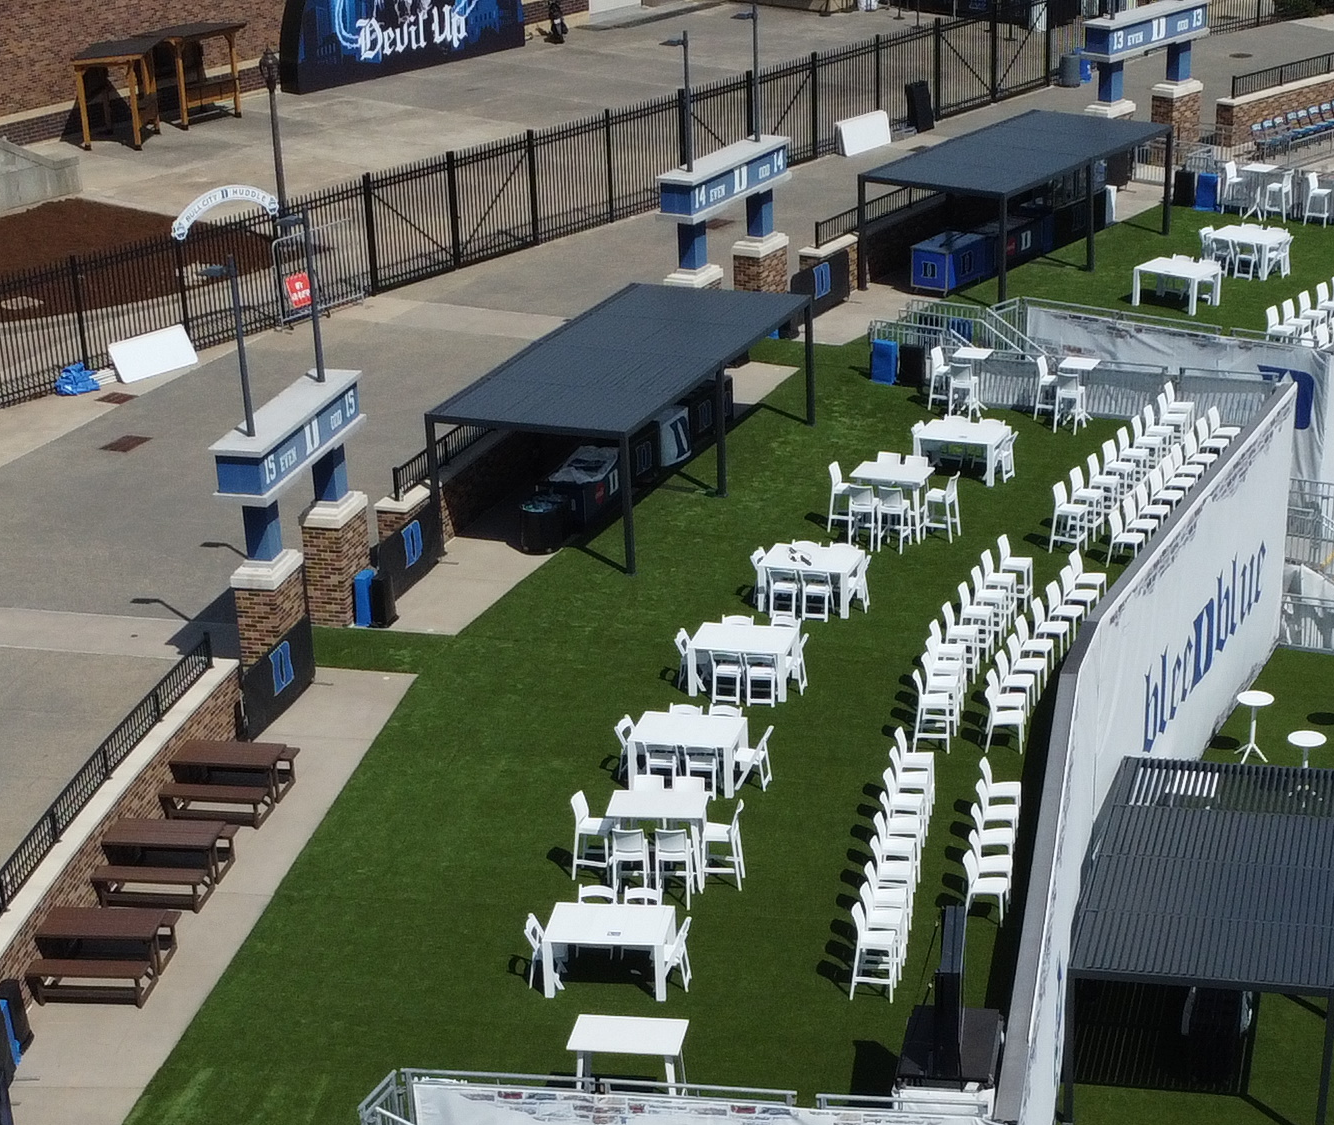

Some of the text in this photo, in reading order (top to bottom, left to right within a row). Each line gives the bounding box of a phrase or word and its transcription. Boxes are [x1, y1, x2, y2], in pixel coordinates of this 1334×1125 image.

[356, 4, 468, 61] Devil Up
[1113, 31, 1124, 51] 13
[1127, 30, 1144, 46] EVEN
[1192, 8, 1202, 28] 13
[185, 205, 202, 222] BULL
[232, 188, 266, 202] HUDDLE
[694, 184, 705, 209] 14
[710, 182, 725, 203] EVEN
[772, 150, 784, 174] 14
[264, 454, 276, 484] 15
[280, 446, 298, 473] EVEN
[345, 388, 356, 418] 15
